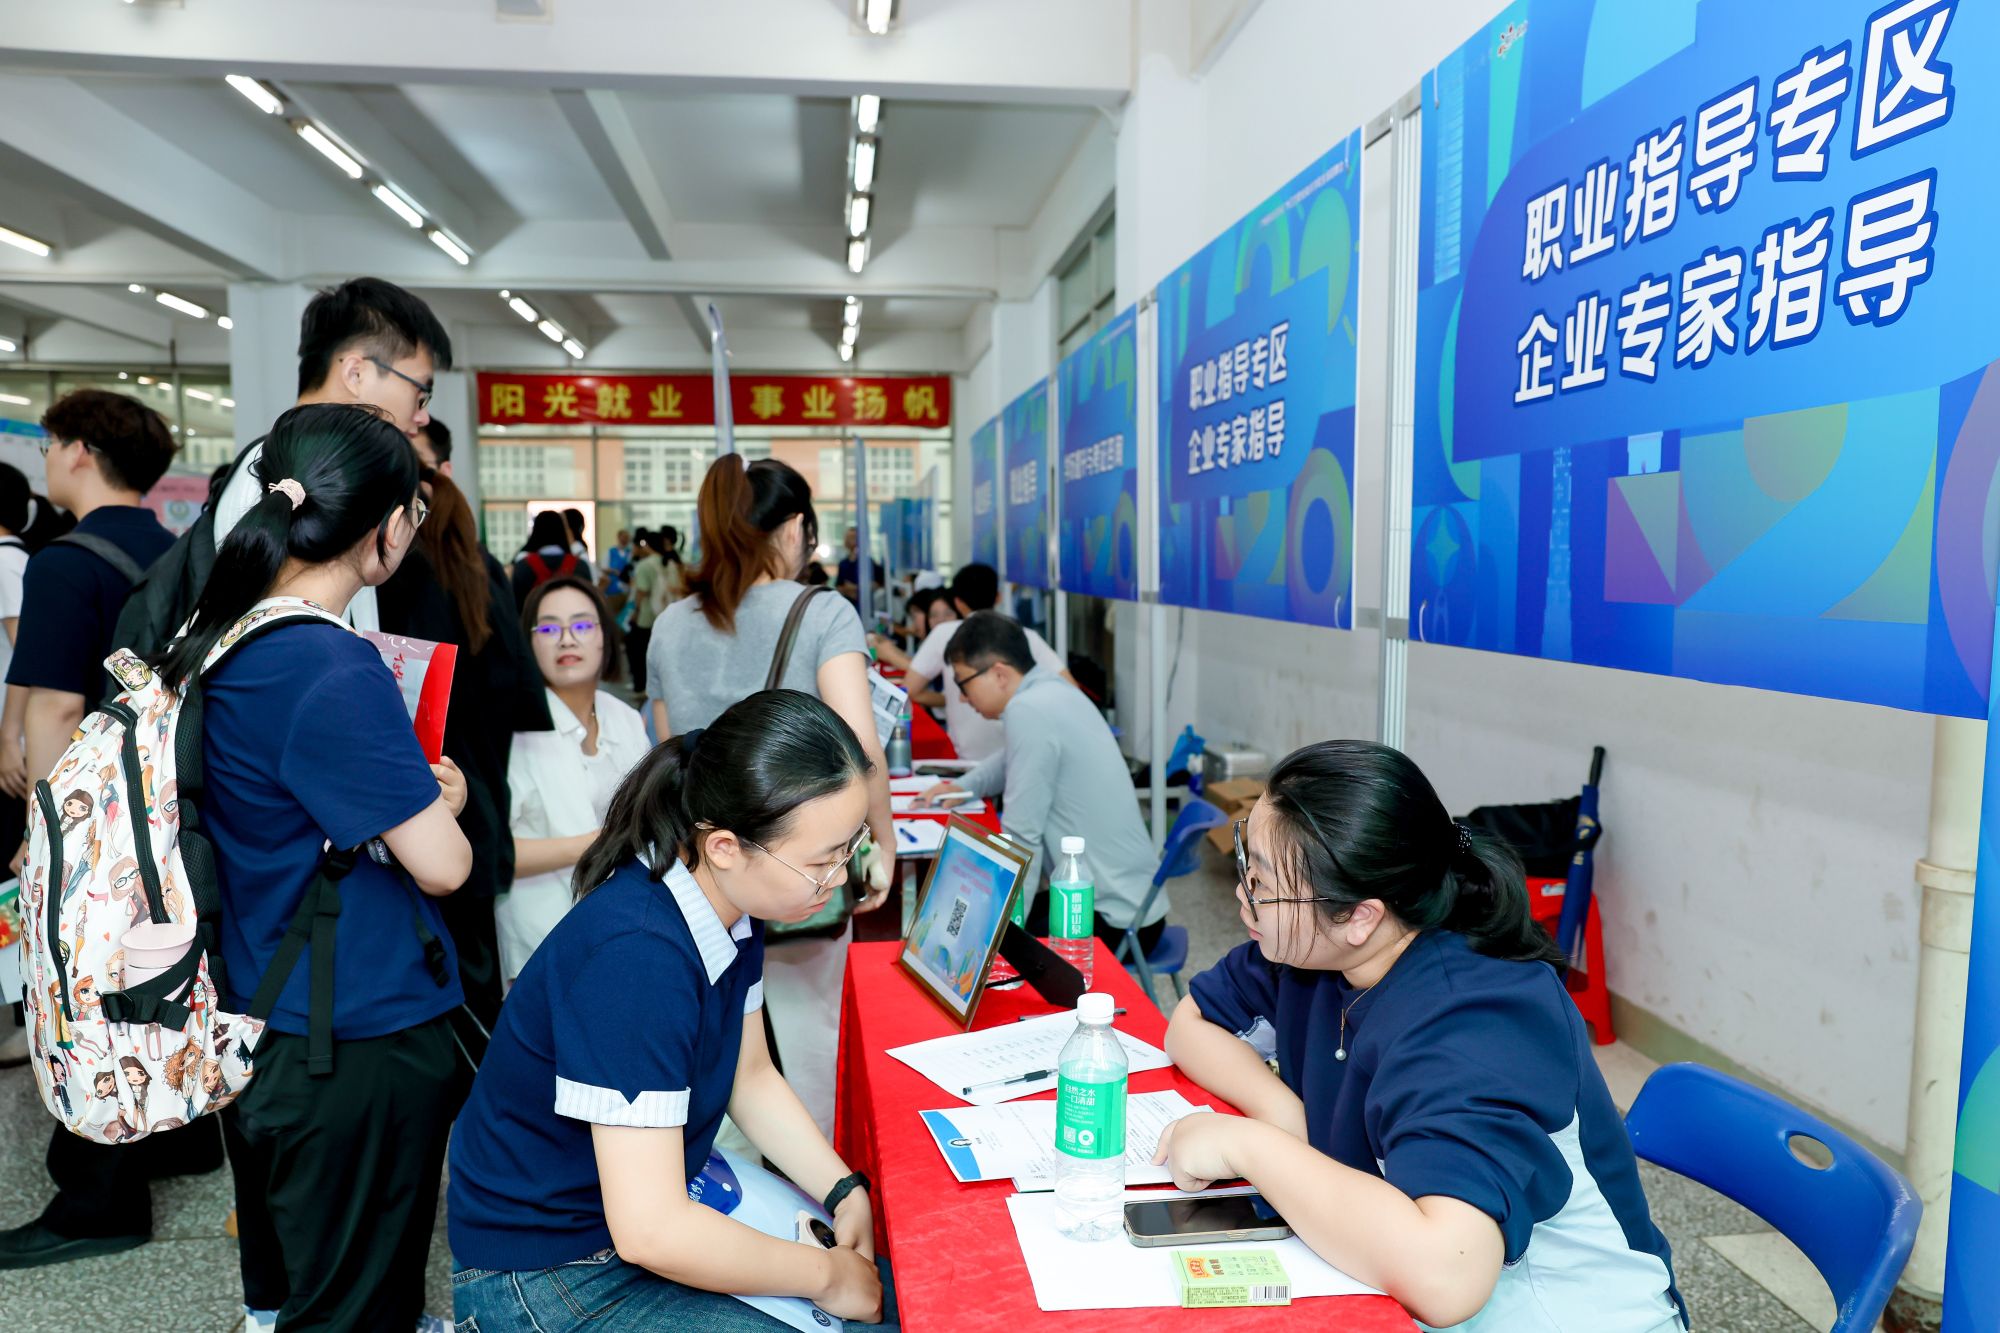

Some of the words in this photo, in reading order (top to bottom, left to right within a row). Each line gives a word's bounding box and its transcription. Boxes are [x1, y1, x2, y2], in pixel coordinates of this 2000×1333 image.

[1521, 0, 1953, 282] 职业指导专区
[1514, 177, 1933, 404] 企业专家指导
[490, 383, 684, 418] 阳光就业
[750, 384, 940, 420] 事业扬帆
[1189, 321, 1290, 411] 职业指导专区
[1187, 400, 1286, 475] 企业专家指导
